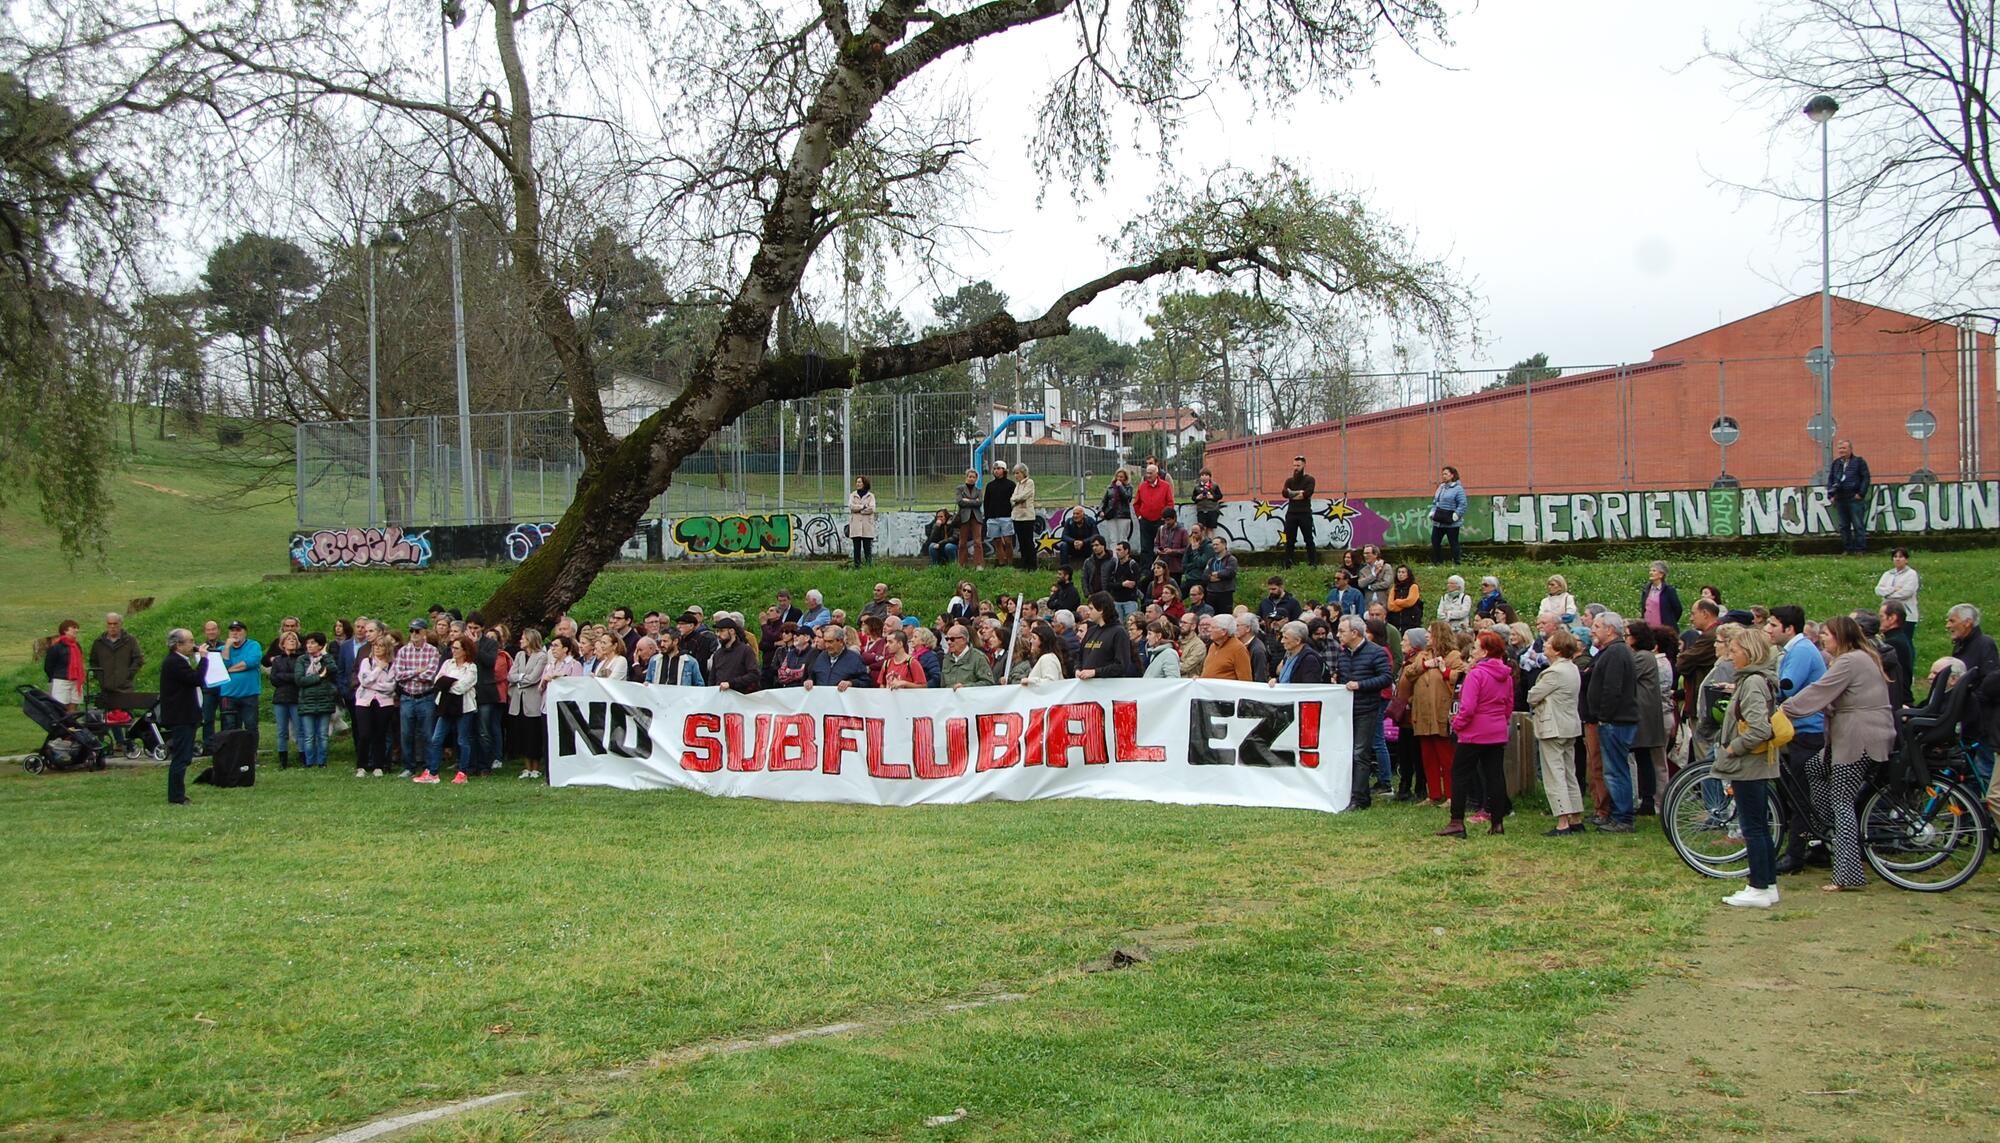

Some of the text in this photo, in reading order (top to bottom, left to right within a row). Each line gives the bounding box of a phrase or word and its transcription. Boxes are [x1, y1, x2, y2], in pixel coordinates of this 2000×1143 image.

[1492, 490, 1710, 543] HERRIEN
[1740, 480, 2000, 536] NORASUN
[557, 699, 1323, 779] NO SUBFLUBIAL EZ!
